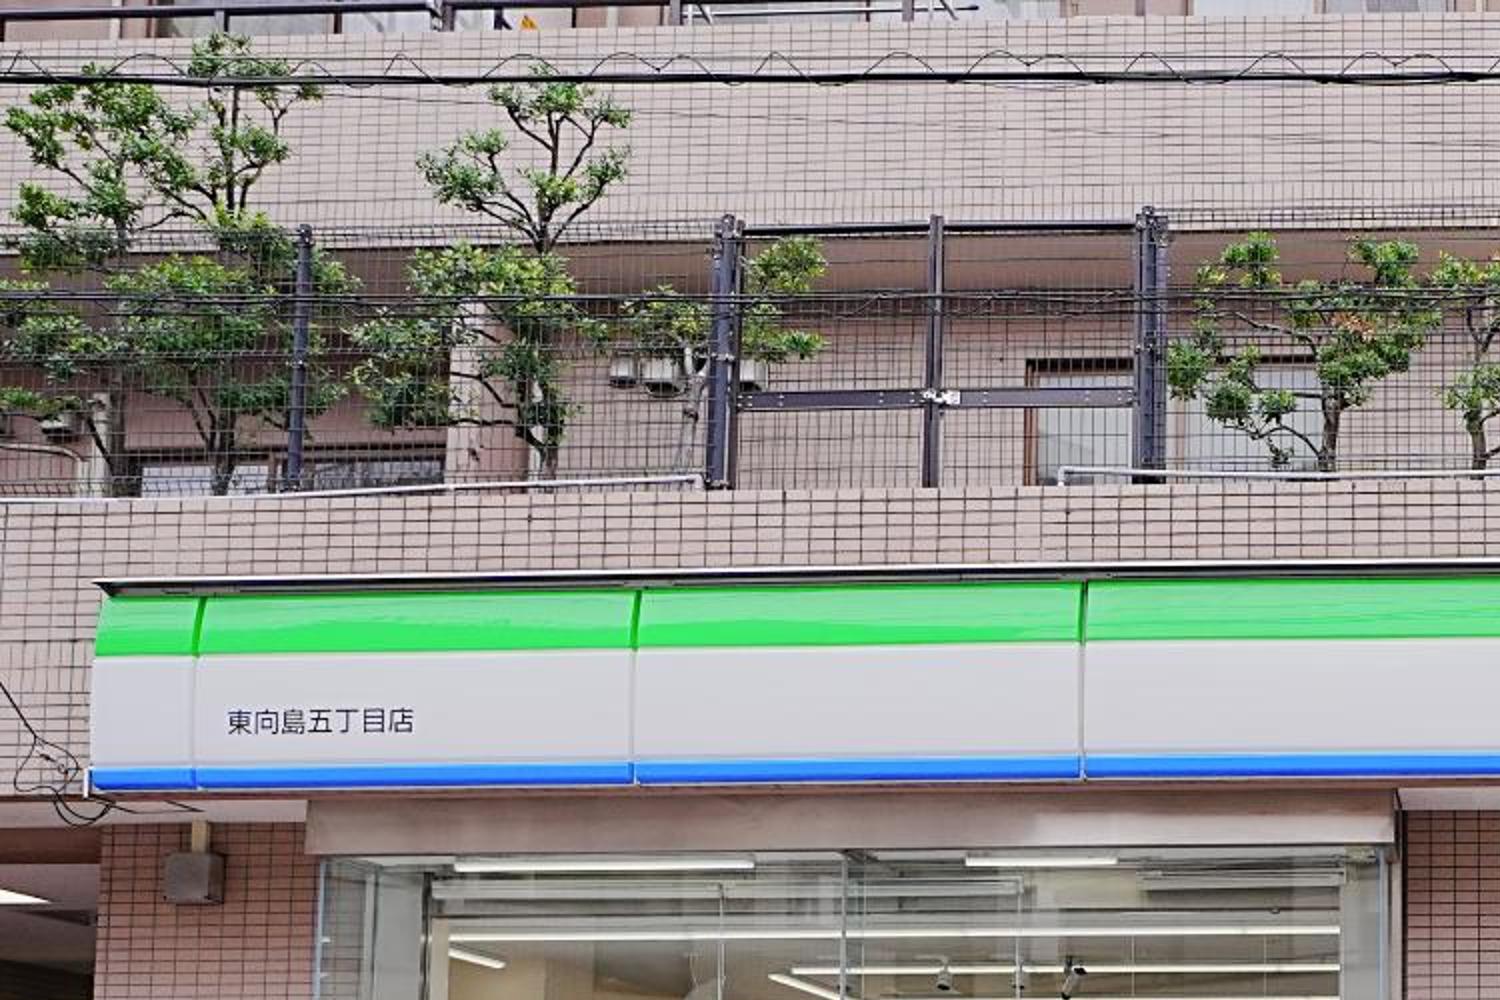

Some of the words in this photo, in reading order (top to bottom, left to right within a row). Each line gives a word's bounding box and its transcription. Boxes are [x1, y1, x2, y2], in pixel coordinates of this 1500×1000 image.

[227, 708, 414, 735] 東向島五丁目店
